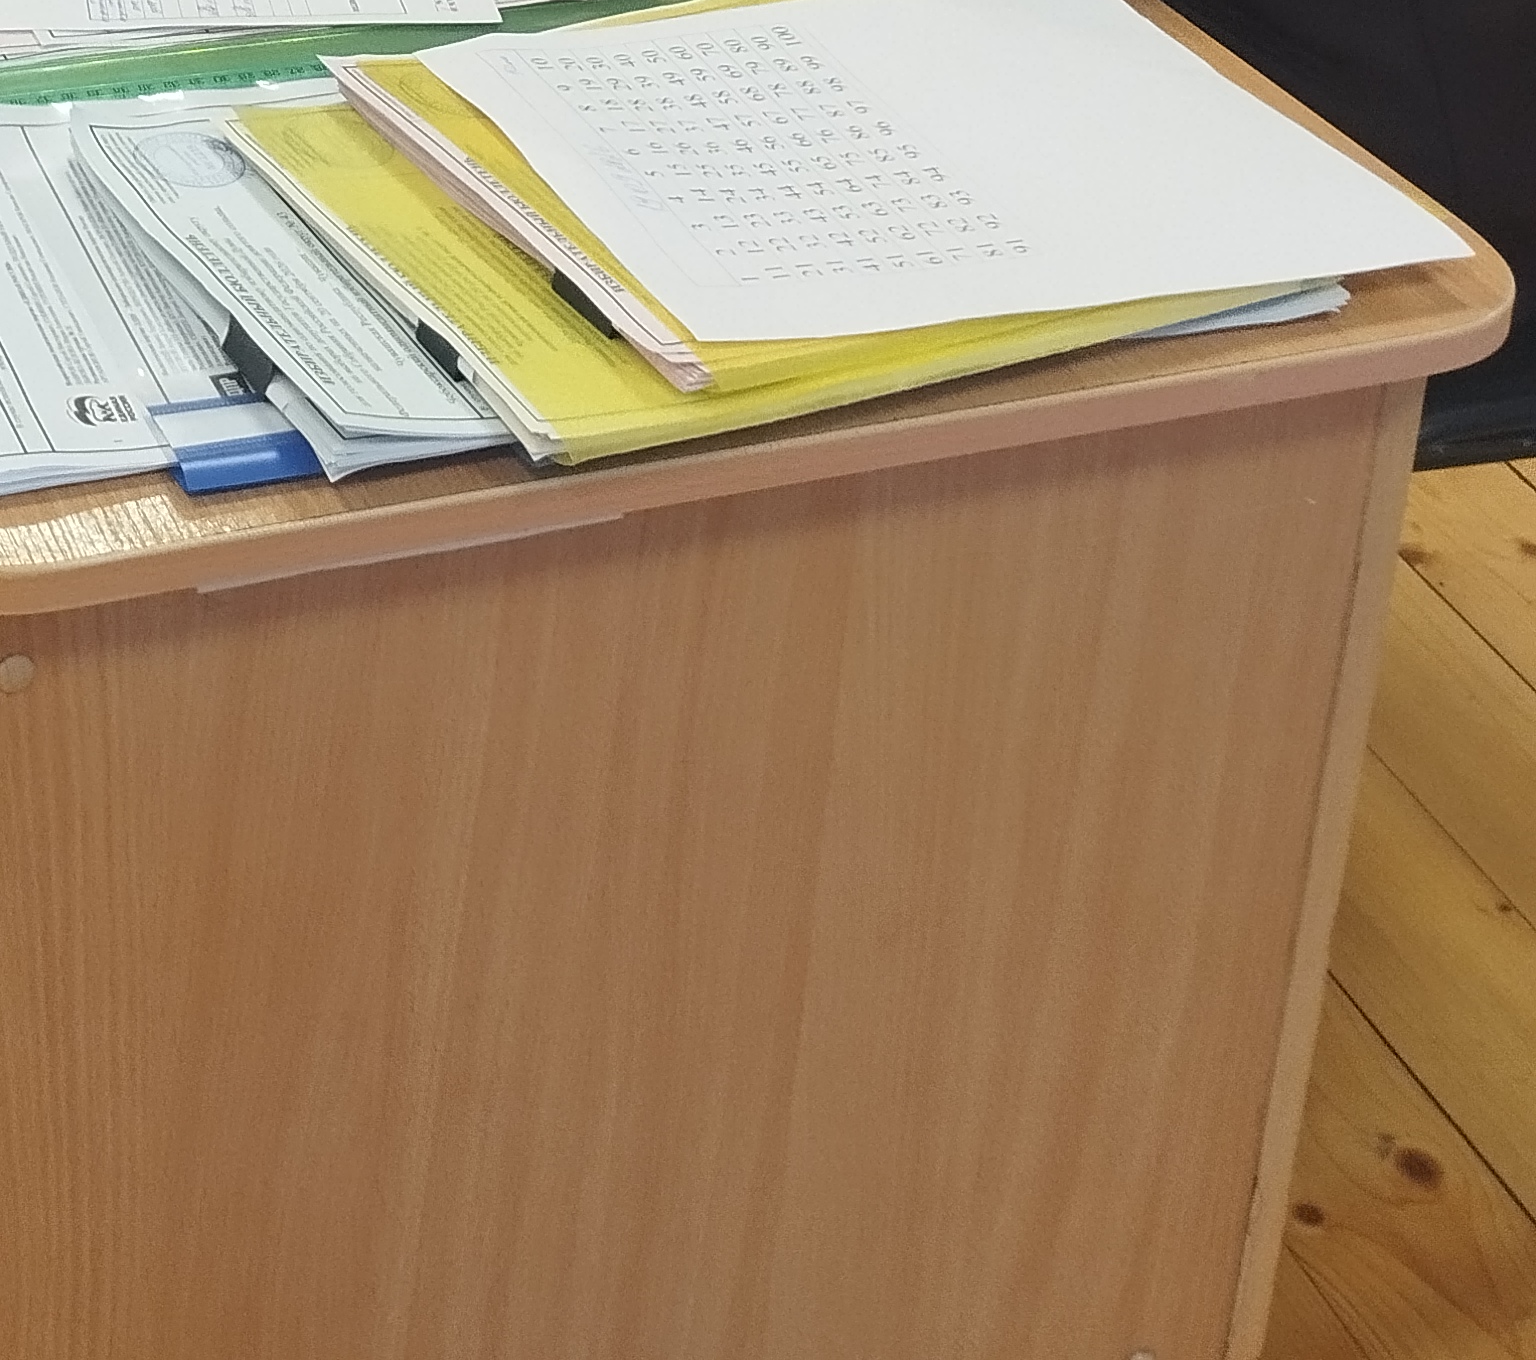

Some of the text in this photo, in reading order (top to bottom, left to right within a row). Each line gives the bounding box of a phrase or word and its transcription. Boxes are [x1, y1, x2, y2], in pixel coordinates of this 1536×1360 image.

[530, 57, 555, 70] 10
[463, 156, 627, 292] ИЗБИРАТЕЛЬНЫЙ БЮЛЛЕТЕНЬ
[558, 58, 790, 279] 11 12 13 14 15 16 17 18 19 20
[586, 57, 823, 276] 21 22 23 24 25 26 27 28 29 30
[614, 54, 852, 273] 31 32 33 34 35 36 37 38 39 40
[642, 46, 880, 271] 41 42 43 44 45 46 47 48 49 50
[669, 46, 914, 267] 51 52 53 54 55 56 57 58 59 60
[186, 234, 335, 384] ИЗБИРАТЕЛЬНЫЙ БЮЛЛЕТЕНЬ
[916, 252, 943, 264] 61
[118, 394, 138, 420] РОССИЯ
